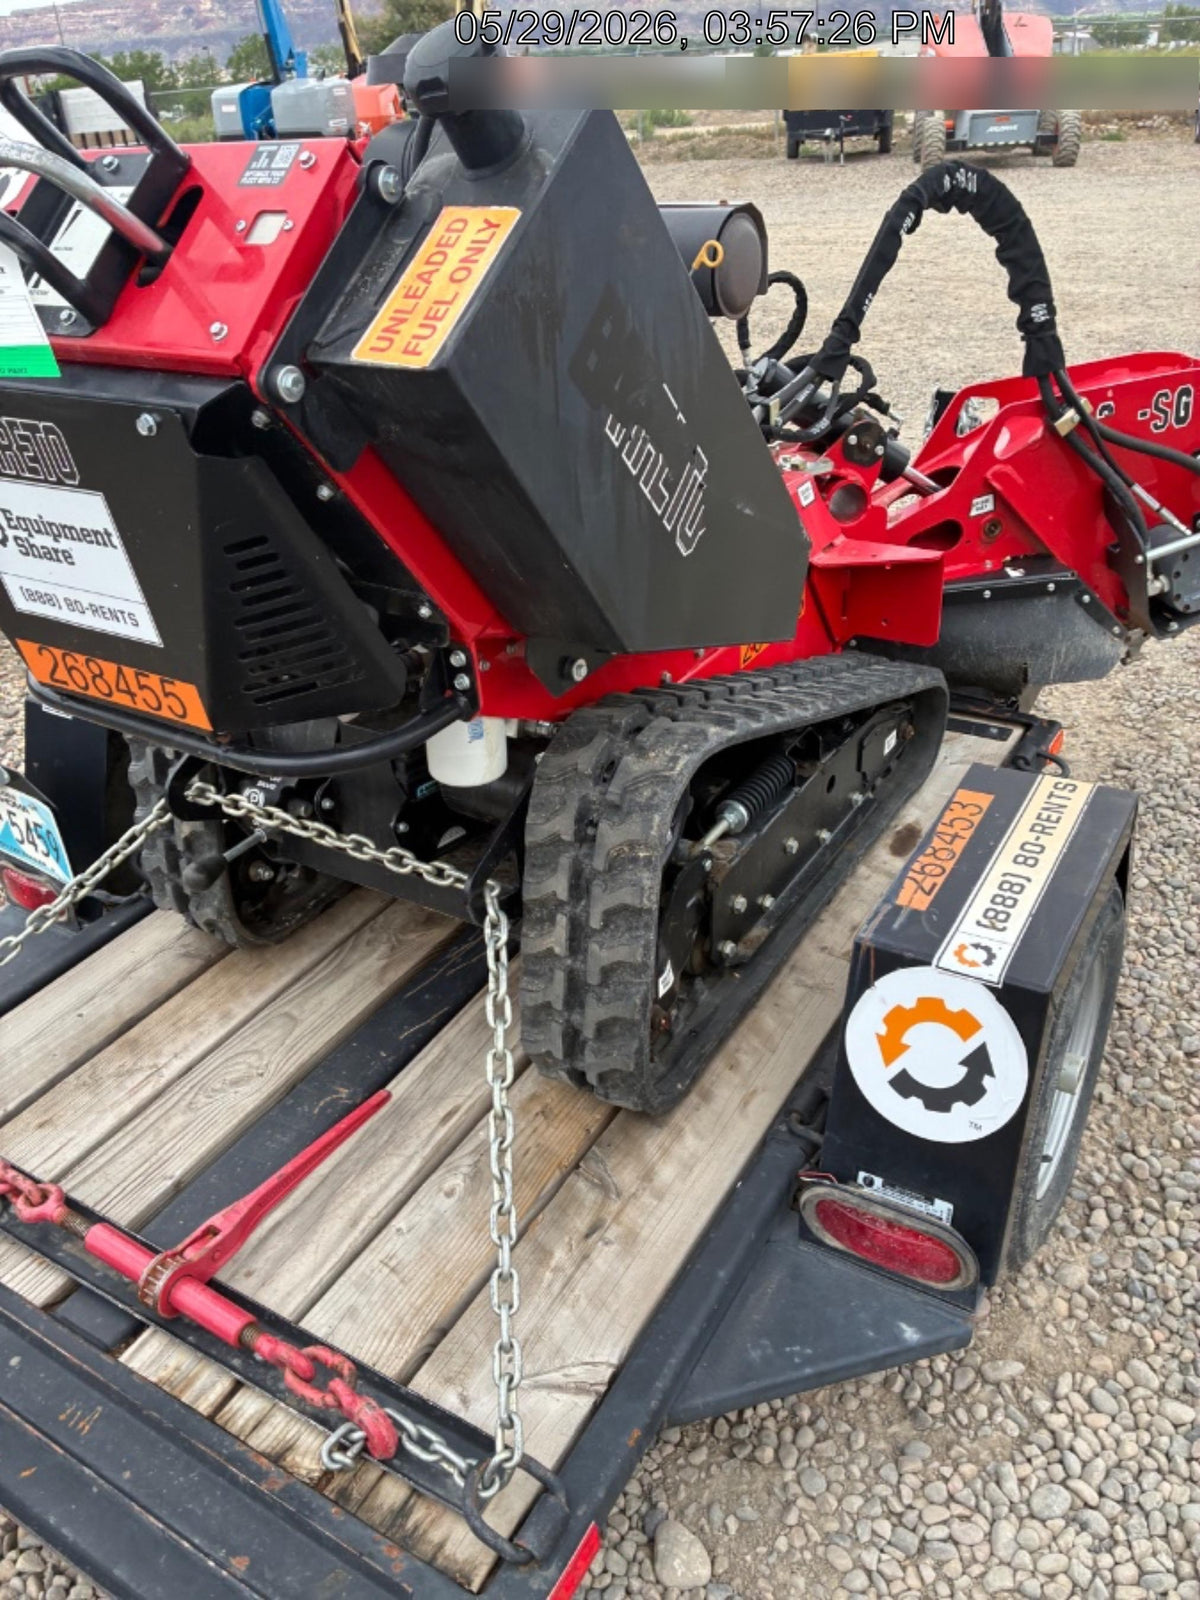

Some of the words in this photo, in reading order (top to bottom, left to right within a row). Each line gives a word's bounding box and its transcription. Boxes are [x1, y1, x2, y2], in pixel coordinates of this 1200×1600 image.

[369, 217, 469, 353] UNLEADED
[401, 291, 461, 357] FUEL
[448, 217, 502, 285] ONLY
[0, 507, 119, 550] Equipment
[13, 534, 76, 567] Share
[19, 585, 63, 611] (888)
[62, 596, 140, 628] 80-RENTS
[37, 644, 188, 719] 268455
[906, 800, 984, 896] 268453
[975, 871, 1032, 932] (888)
[1013, 780, 1079, 869] 80-RENTS
